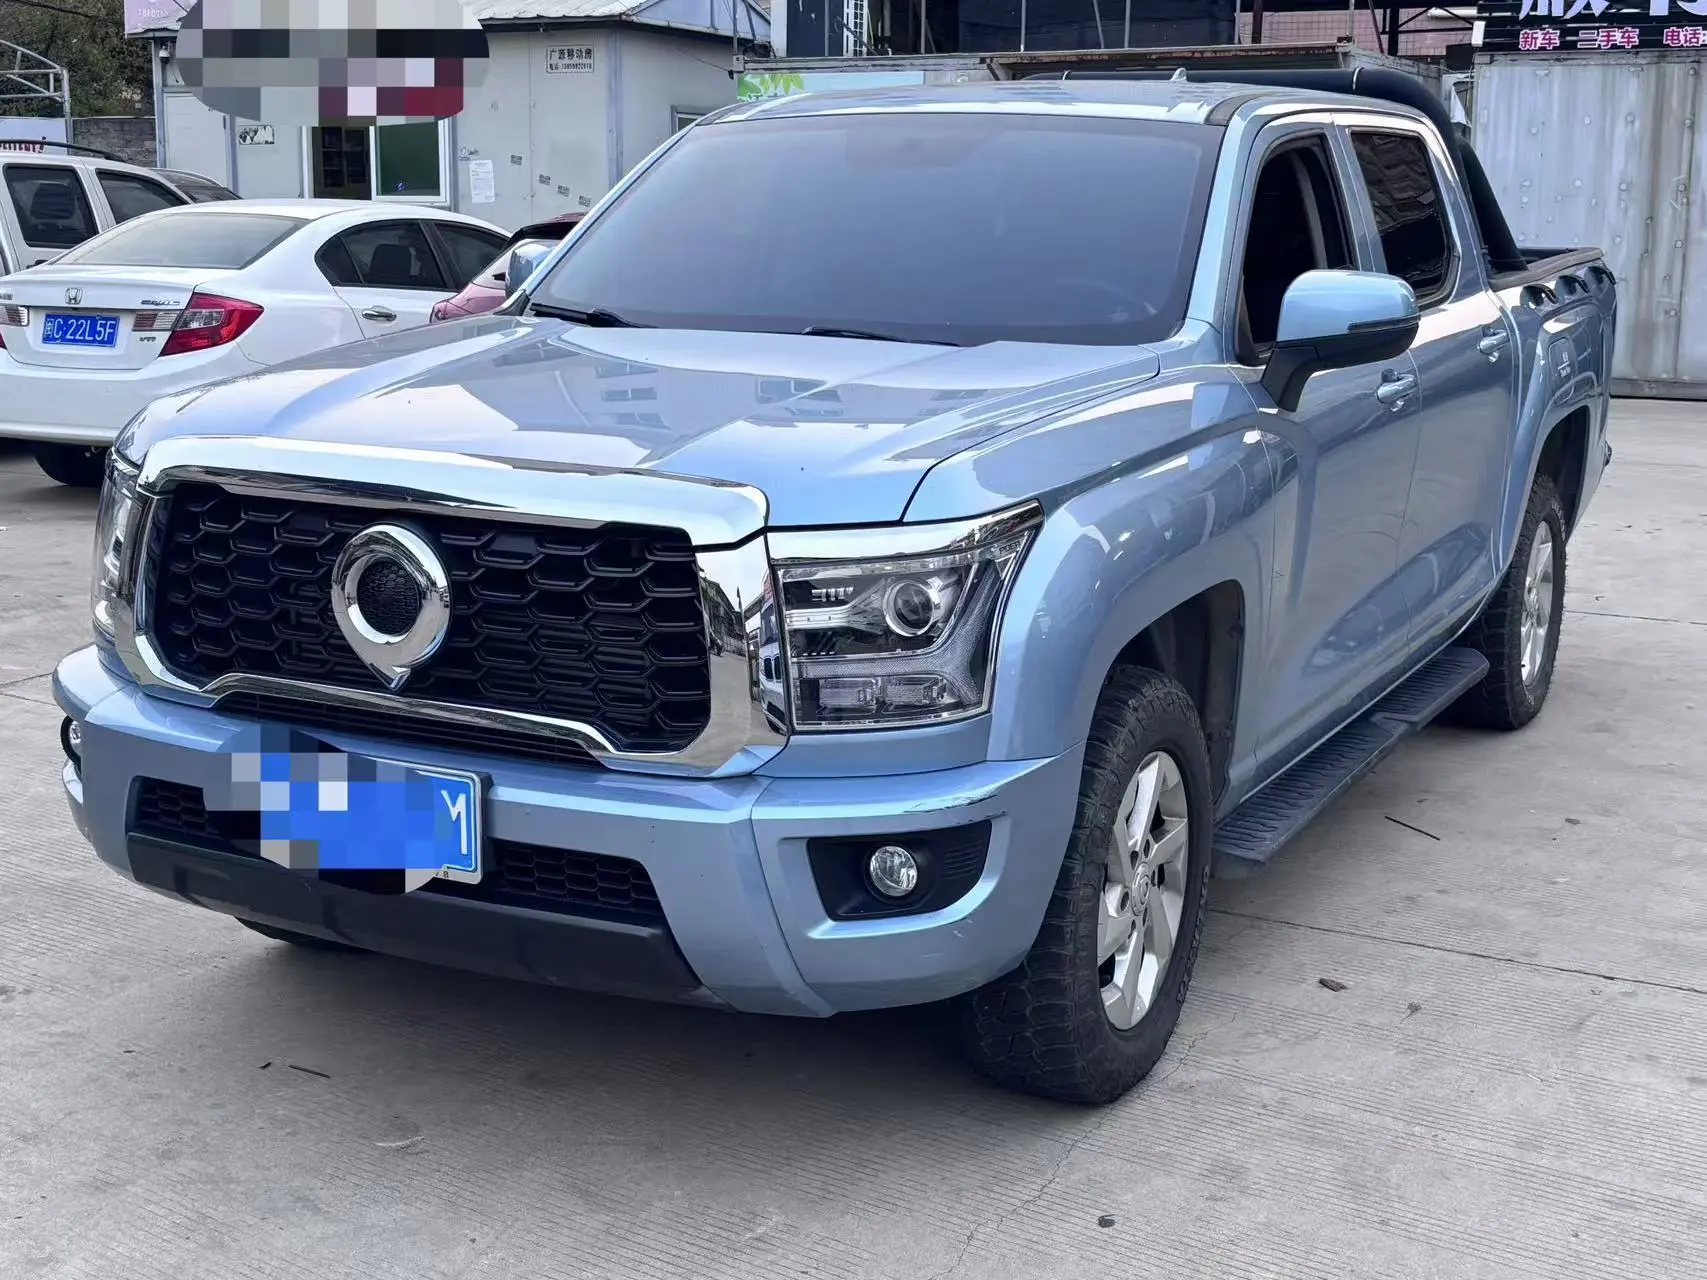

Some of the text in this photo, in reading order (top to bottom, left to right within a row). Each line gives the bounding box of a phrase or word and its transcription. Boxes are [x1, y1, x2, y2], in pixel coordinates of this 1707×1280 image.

[1519, 28, 1560, 50] 新车
[1577, 27, 1639, 48] 二手车
